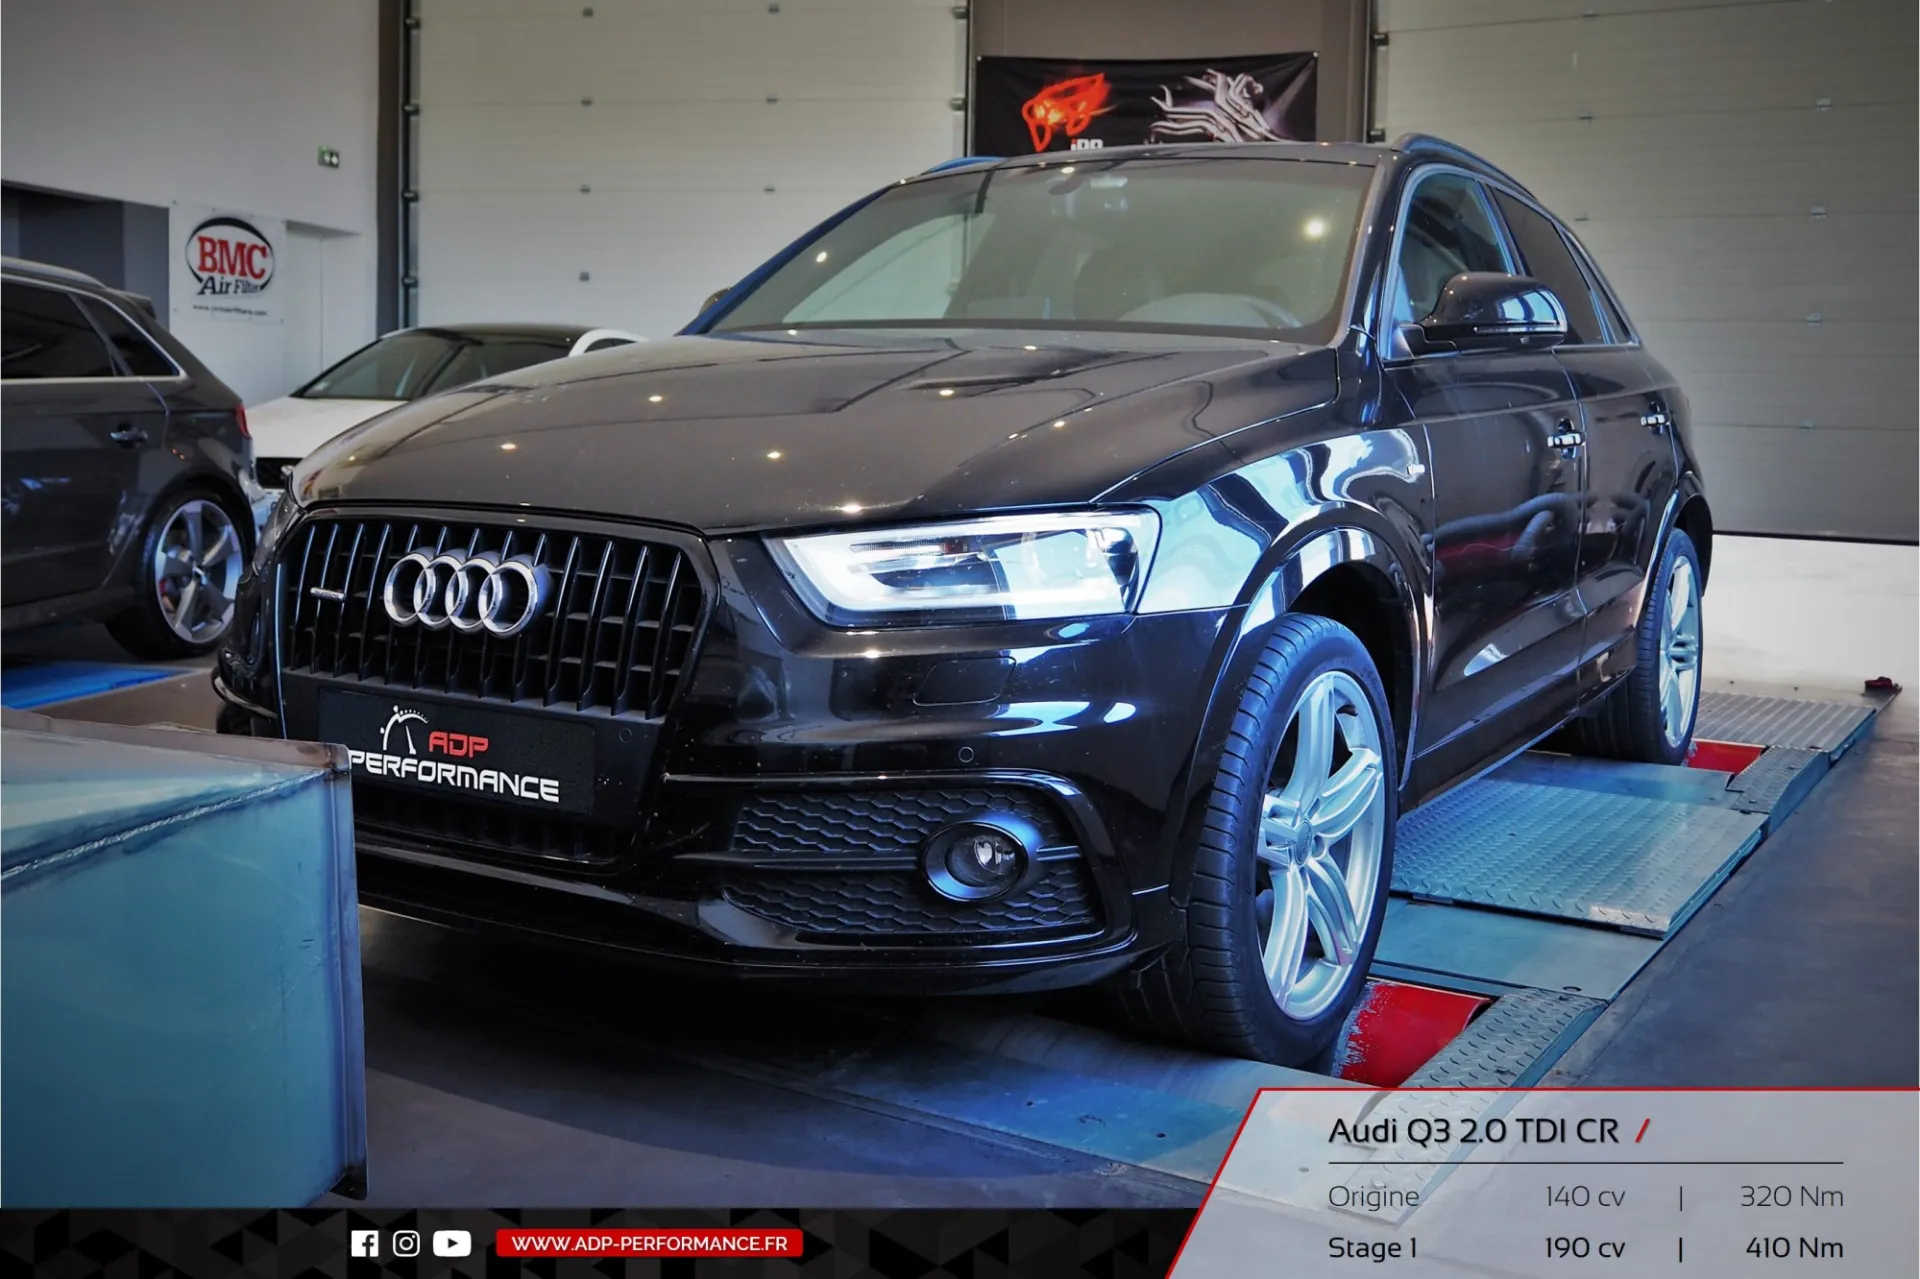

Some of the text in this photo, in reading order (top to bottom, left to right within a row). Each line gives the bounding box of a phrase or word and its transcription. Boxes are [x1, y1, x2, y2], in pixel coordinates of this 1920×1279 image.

[197, 236, 267, 280] BMC
[197, 275, 231, 295] Air
[428, 731, 489, 759] ADP
[349, 749, 560, 803] PERFORMANCE
